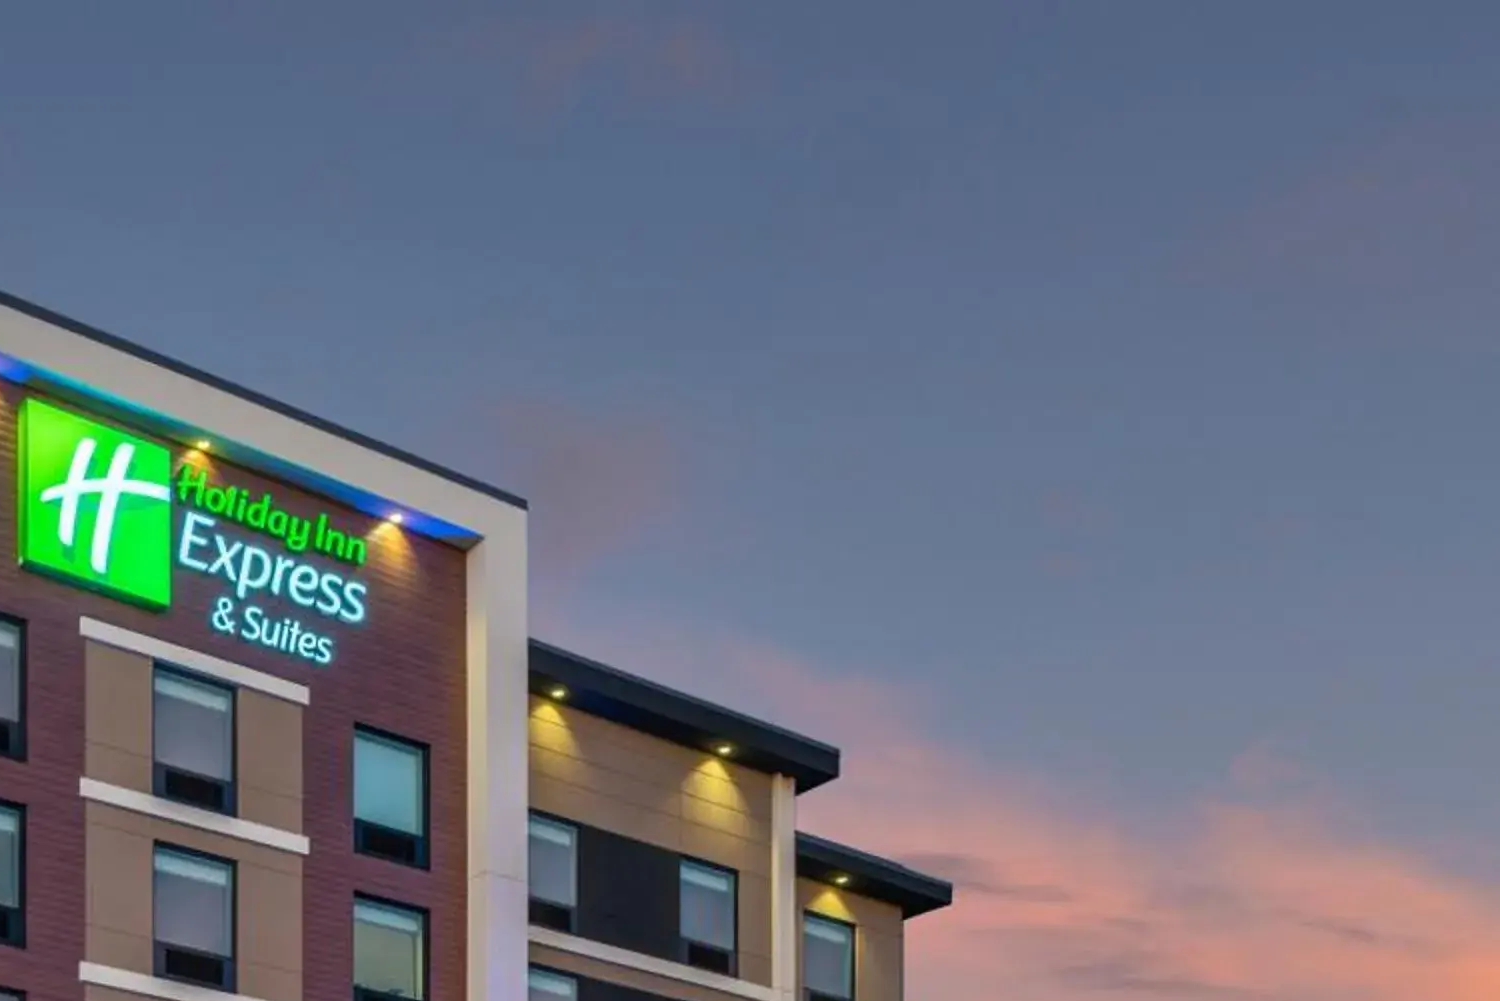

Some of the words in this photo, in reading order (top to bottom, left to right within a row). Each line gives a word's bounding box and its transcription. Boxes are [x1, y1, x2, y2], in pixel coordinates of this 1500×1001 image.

[176, 464, 311, 551] Holiday
[315, 514, 367, 565] Inn
[179, 512, 367, 622] Express
[212, 597, 235, 634] &
[241, 608, 334, 665] Suites
